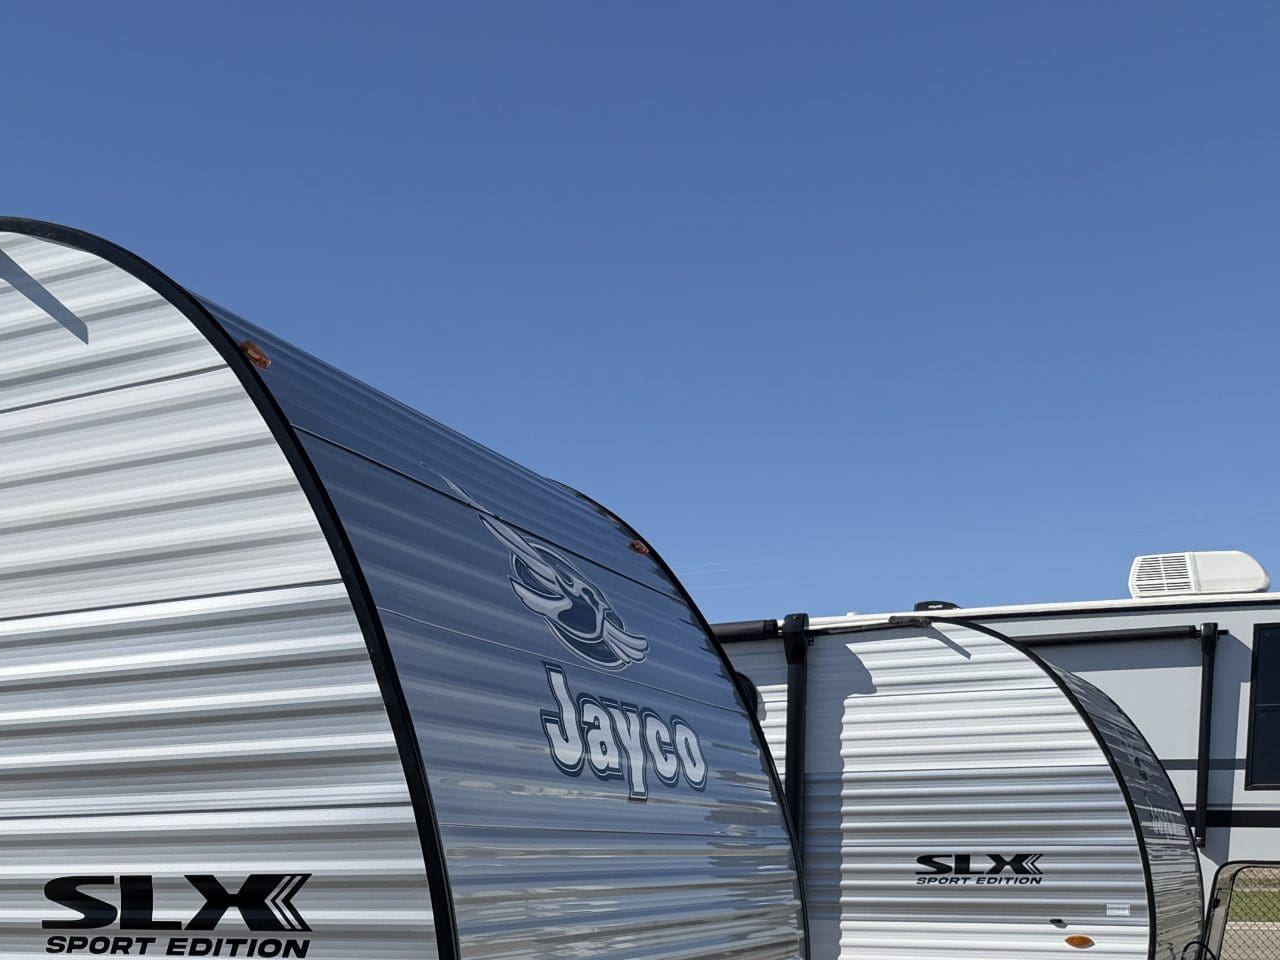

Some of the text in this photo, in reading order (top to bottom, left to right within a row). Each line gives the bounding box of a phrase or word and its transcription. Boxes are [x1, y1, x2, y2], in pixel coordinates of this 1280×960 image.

[540, 661, 708, 802] Jayco
[915, 854, 1044, 875] SLX
[916, 875, 1043, 885] SPORT EDITION
[42, 873, 312, 932] SLX
[45, 936, 312, 959] SPORT EDITION
